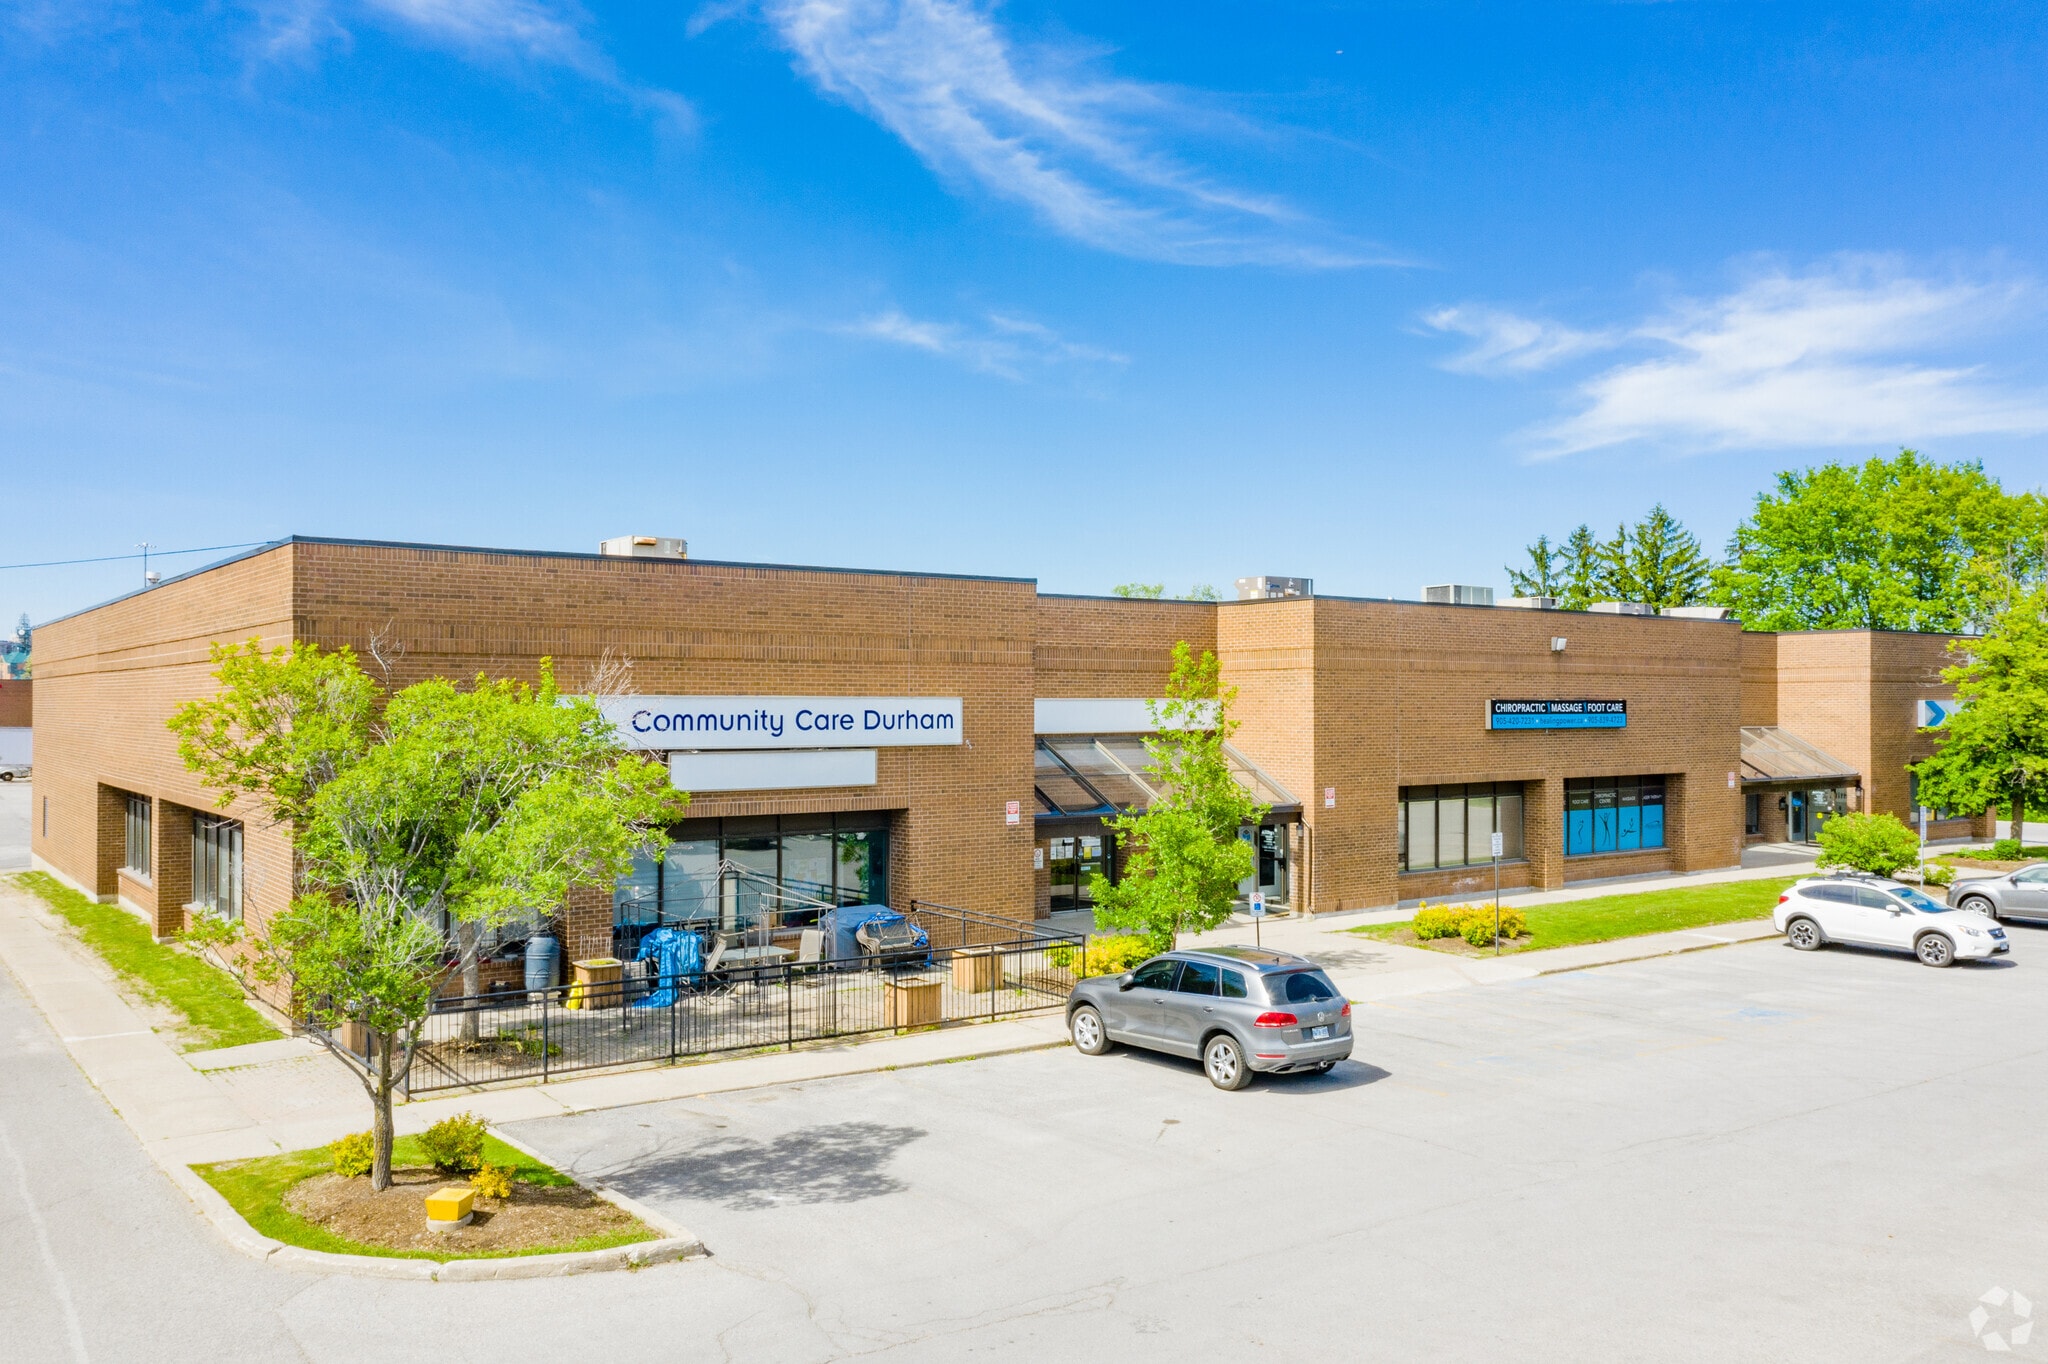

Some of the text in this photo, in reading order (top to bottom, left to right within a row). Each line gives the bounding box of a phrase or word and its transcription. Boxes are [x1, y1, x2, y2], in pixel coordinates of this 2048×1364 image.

[1495, 703, 1623, 713] CHIROPRACTIC MASSAGE FOOT CARE
[632, 709, 954, 738] Community Care Durham
